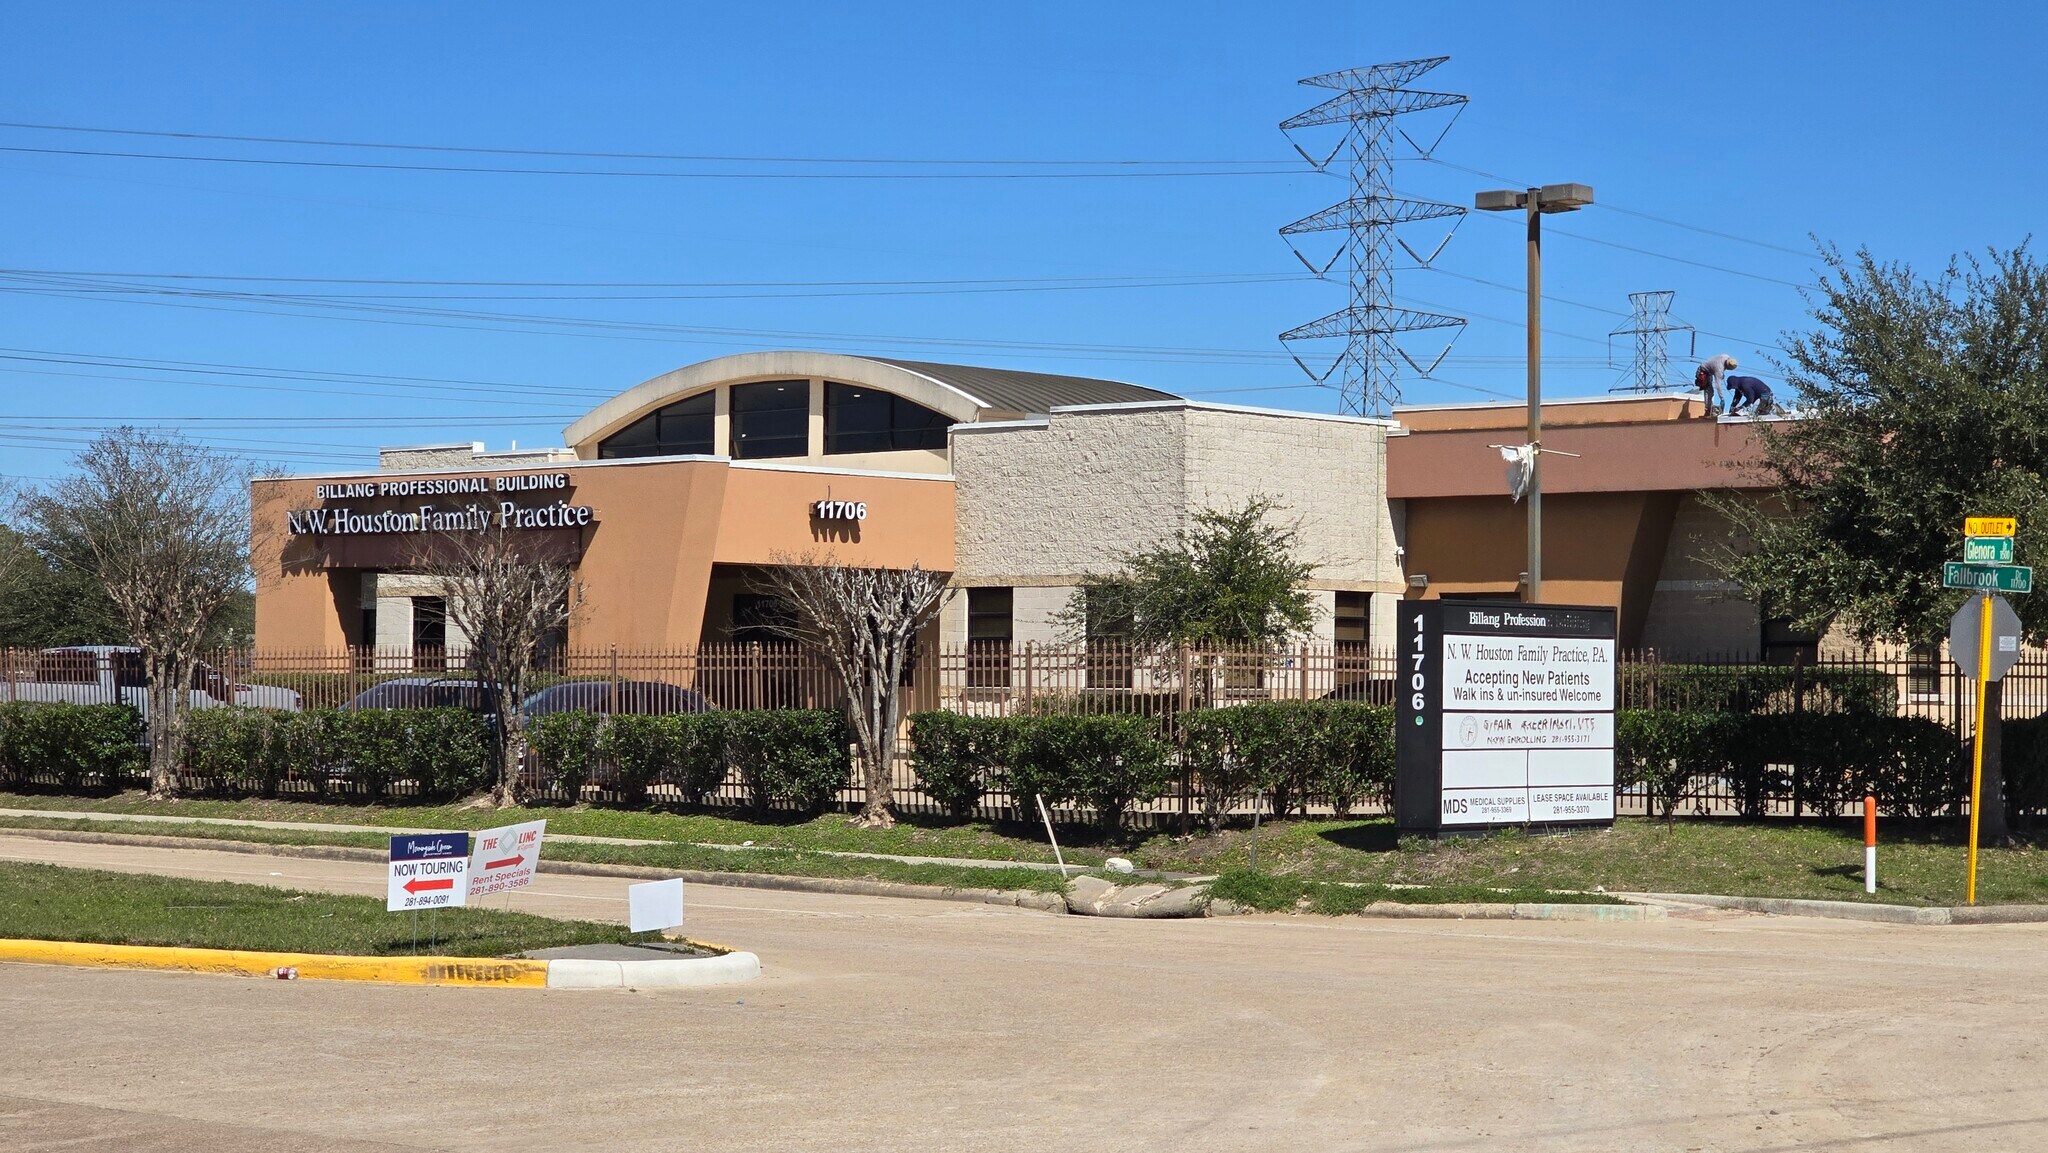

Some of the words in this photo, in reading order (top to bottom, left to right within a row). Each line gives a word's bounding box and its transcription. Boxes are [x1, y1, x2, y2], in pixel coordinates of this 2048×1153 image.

[316, 482, 375, 499] BILLANG
[380, 477, 489, 496] PROFESSIONAL
[495, 474, 566, 492] BUILDING
[287, 508, 329, 535] N.W.
[333, 509, 416, 534] Houston
[419, 503, 491, 535] Family
[500, 500, 589, 529] Practice
[817, 501, 867, 520] 11706
[1968, 522, 1977, 534] NO
[1981, 522, 2004, 534] OUTLET
[1967, 541, 1995, 560] Glenora
[1948, 565, 1998, 587] Fallbrook
[1469, 611, 1500, 628] Billang
[1447, 643, 1457, 660] N.
[1461, 644, 1471, 660] W.
[1476, 644, 1513, 661] Houston
[1517, 645, 1549, 665] Family
[1552, 645, 1590, 664] Practice,
[1592, 647, 1608, 663] P.A.
[1465, 669, 1519, 688] Accepting
[1522, 670, 1544, 685] New
[1548, 671, 1590, 686] Patients
[1453, 686, 1476, 701] Walk
[1479, 687, 1495, 701] ins
[1497, 688, 1504, 701] &
[1507, 688, 1558, 701] un-insured
[1560, 688, 1602, 701] Welcome
[1487, 736, 1505, 744] NOW
[1507, 735, 1547, 744] ENROLLING
[1443, 798, 1468, 814] MDS
[1470, 798, 1497, 806] MEDICAL
[1498, 796, 1526, 805] SUPPLIES
[1533, 793, 1553, 803] LEASE
[1554, 793, 1574, 802] SPACE
[1575, 792, 1609, 801] AVAILABLE
[1553, 805, 1590, 814] 281-955-3370
[482, 837, 498, 850] THE
[518, 830, 537, 844] LINC
[394, 863, 418, 877] NOW
[421, 861, 463, 874] TOURING
[472, 876, 493, 886] Rent
[495, 868, 531, 882] Specials
[469, 877, 529, 896] 281-890-3586
[404, 895, 449, 907] 281-894-0091
